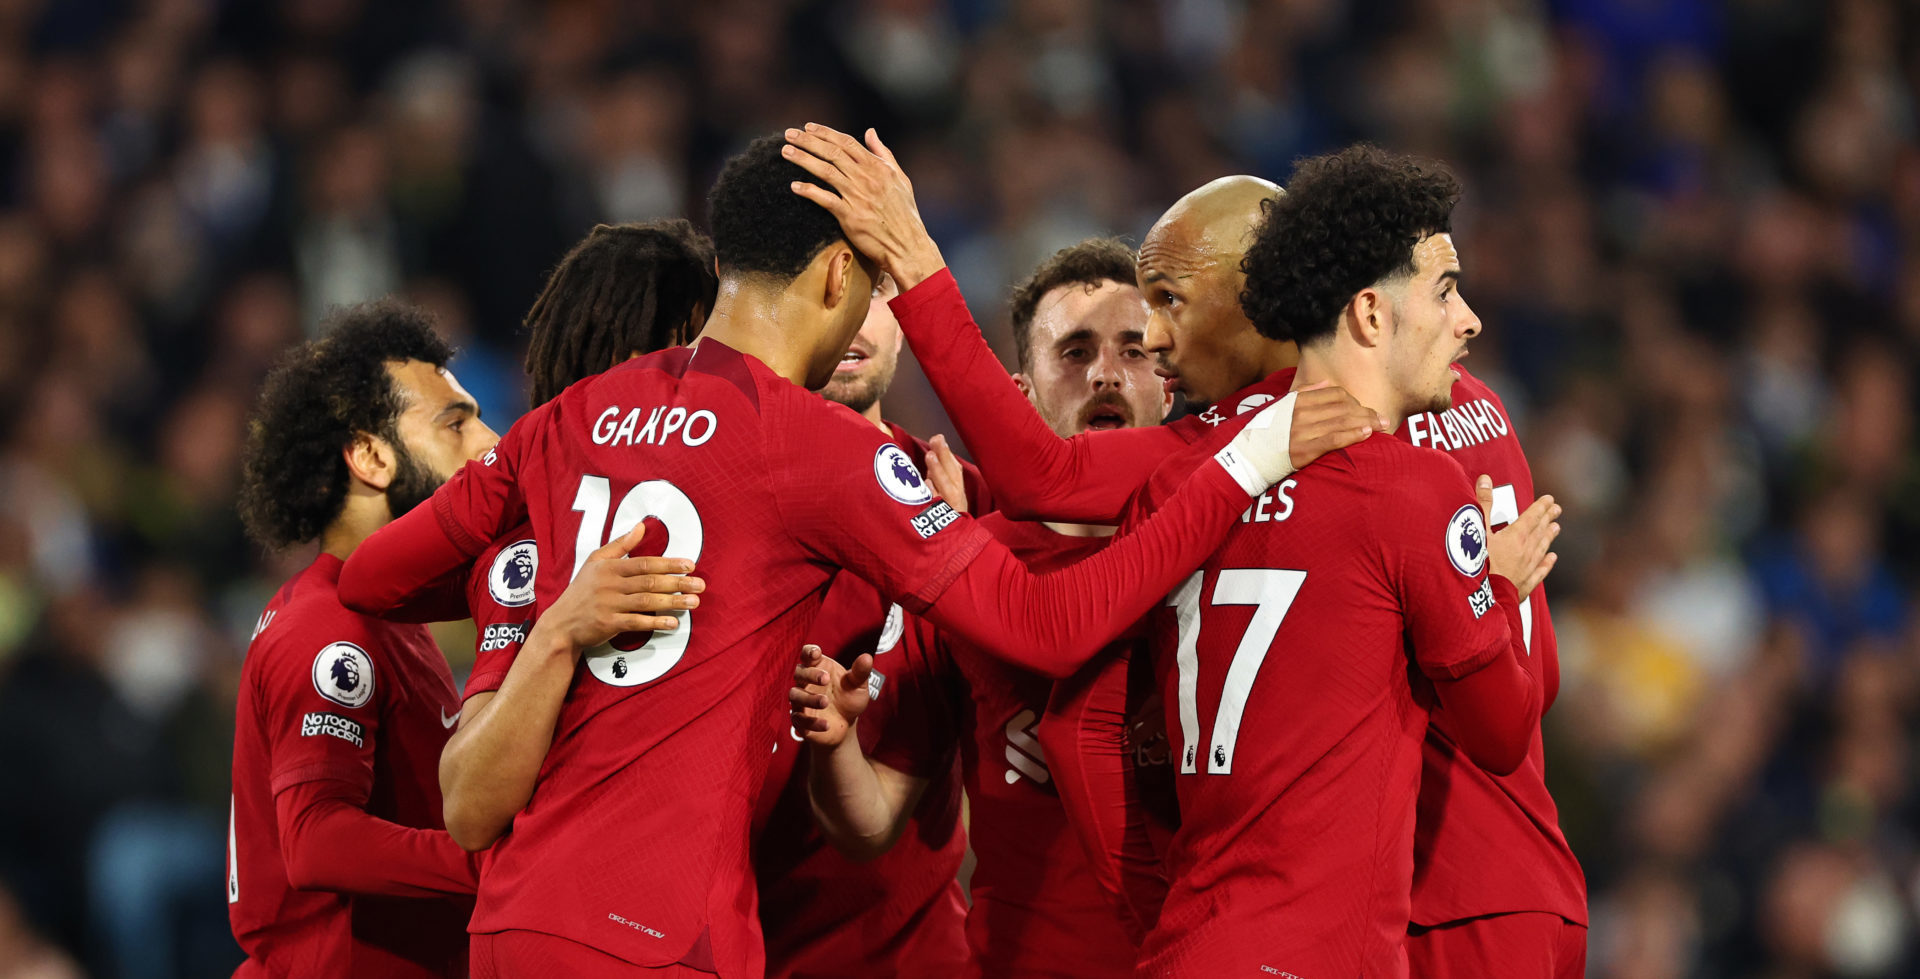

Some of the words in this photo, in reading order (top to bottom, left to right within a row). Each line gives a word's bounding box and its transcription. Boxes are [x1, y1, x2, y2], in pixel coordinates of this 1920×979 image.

[592, 405, 718, 447] GAKPO
[1407, 398, 1508, 451] FABINHO
[910, 516, 930, 531] No
[1467, 590, 1486, 608] No
[1165, 567, 1308, 775] 17
[301, 723, 322, 737] for
[321, 724, 363, 748] racism
[303, 712, 324, 726] No
[324, 714, 361, 736] room
